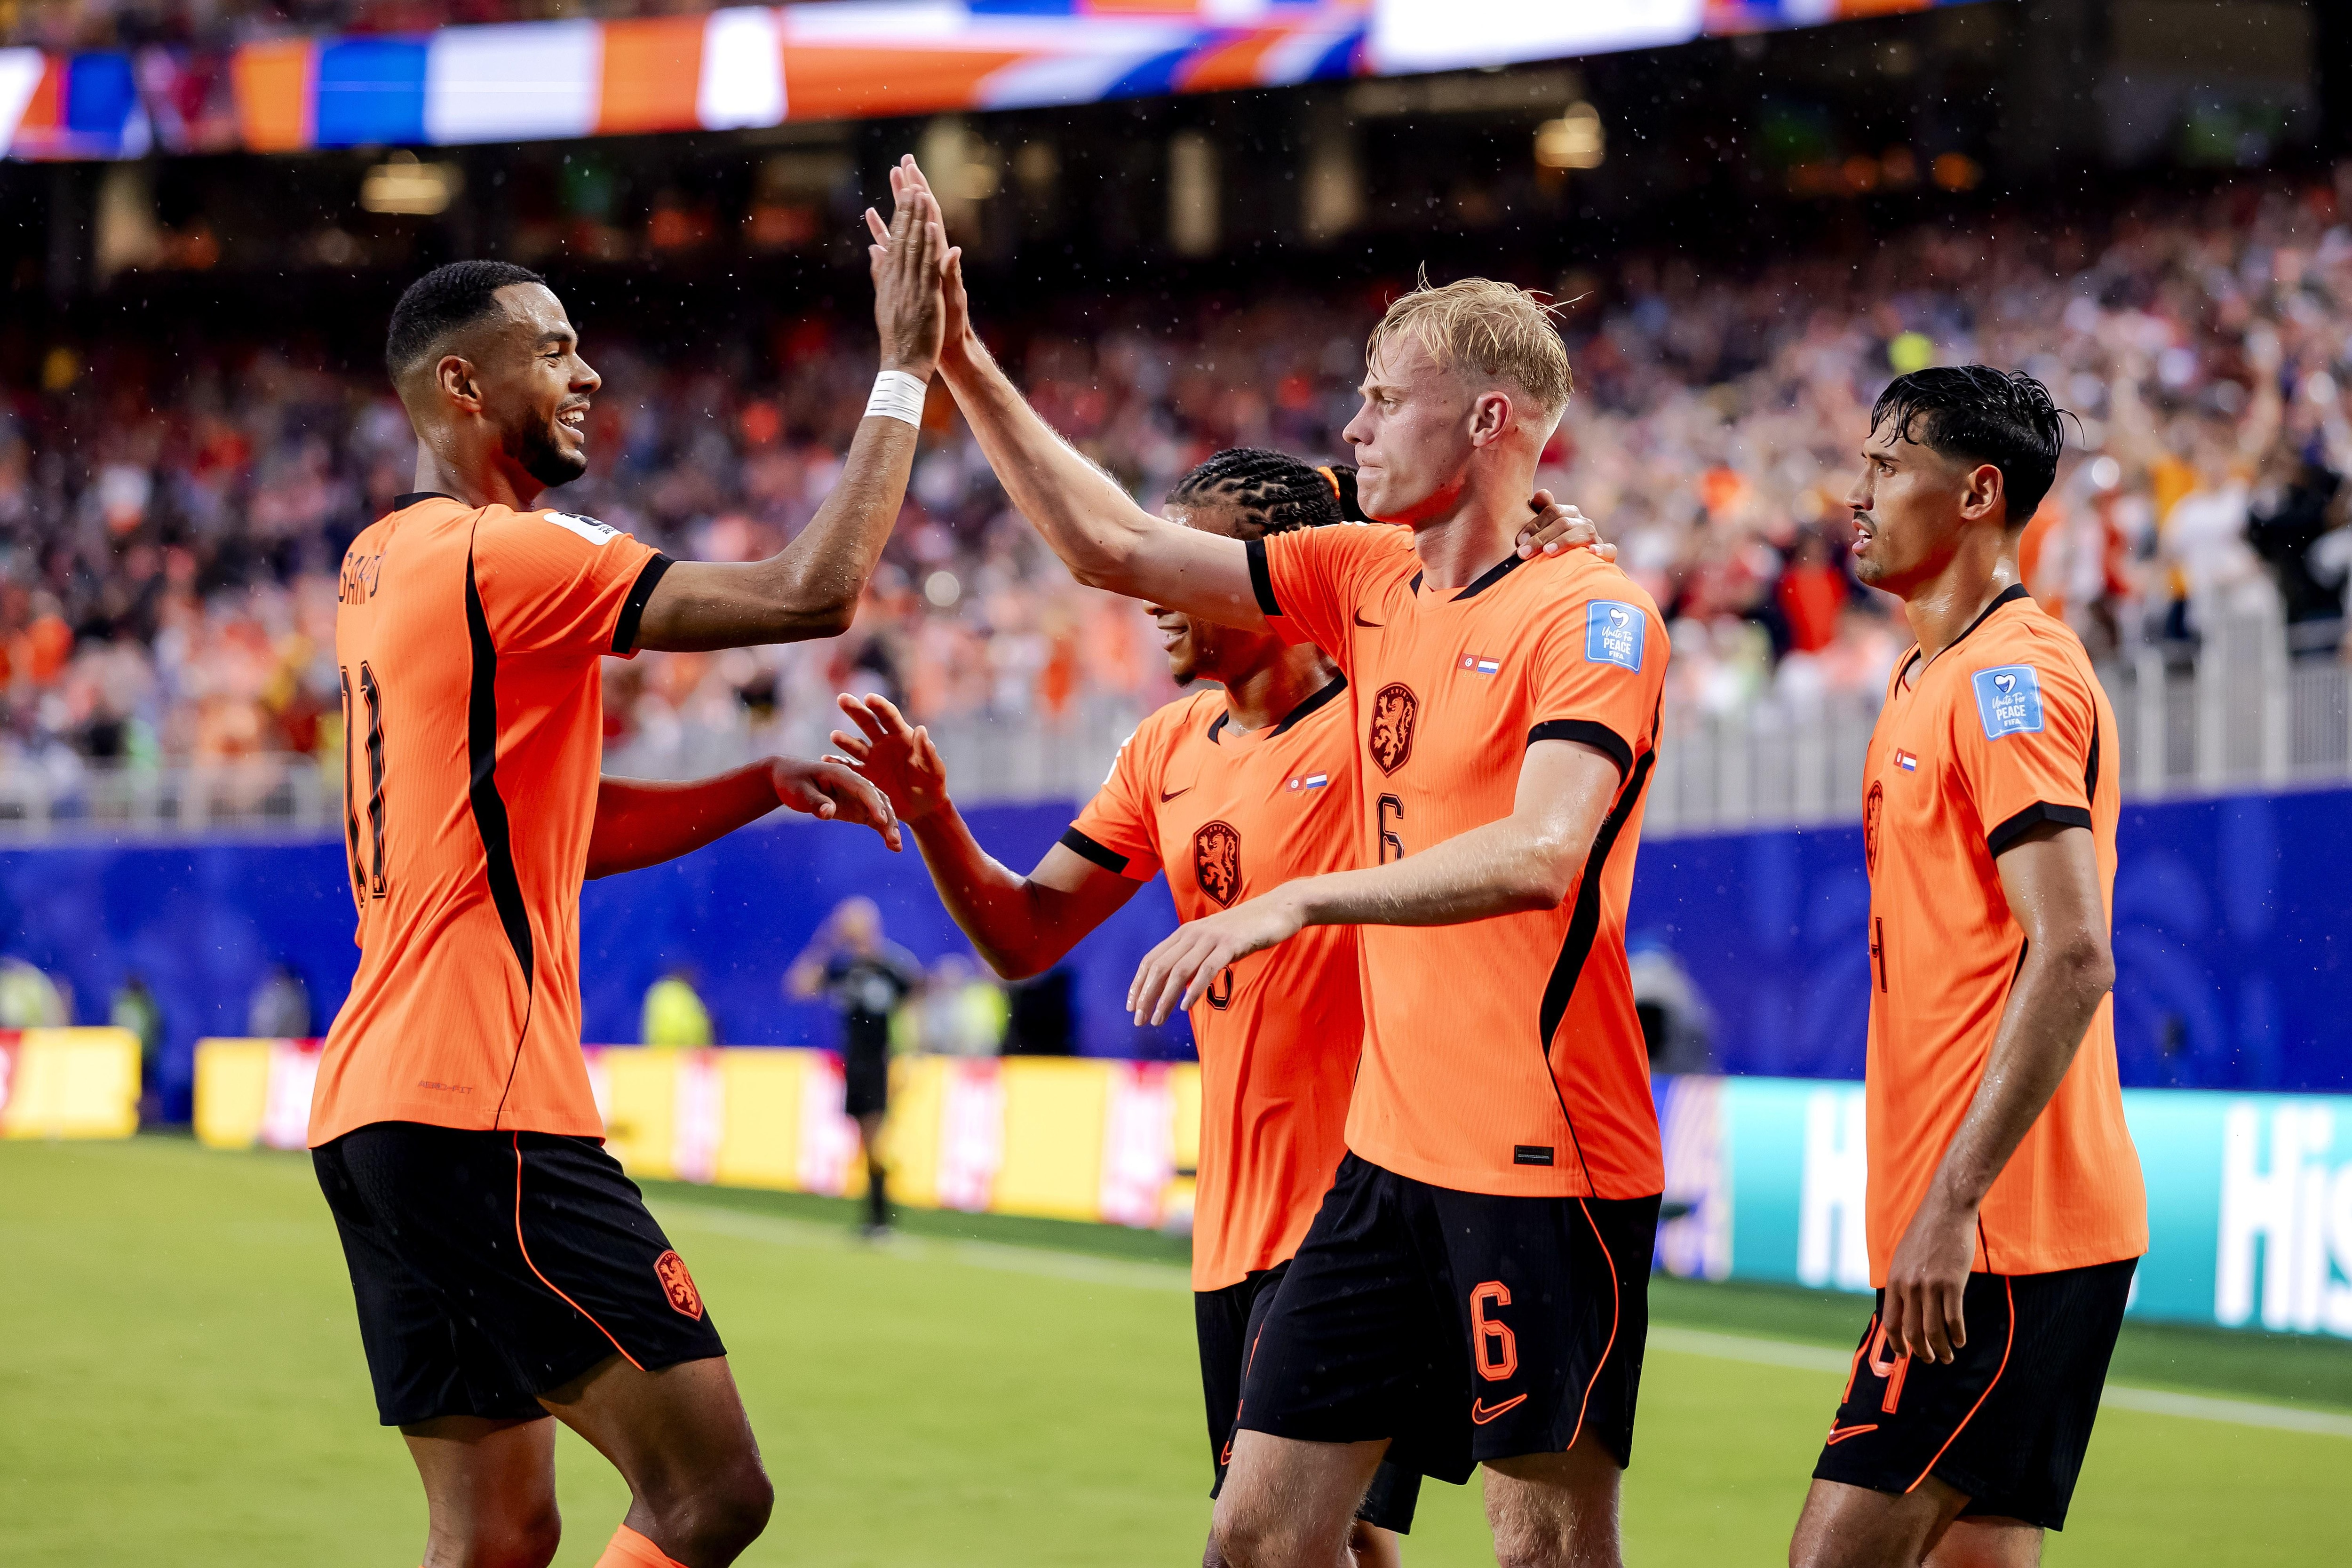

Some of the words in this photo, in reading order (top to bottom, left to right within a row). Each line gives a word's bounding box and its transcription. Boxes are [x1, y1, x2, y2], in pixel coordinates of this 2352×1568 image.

[1602, 626, 1623, 637] Unite
[1622, 631, 1633, 642] For
[1604, 638, 1631, 654] PEACE
[1609, 651, 1624, 660] FIFA
[1992, 695, 2013, 709] Unite
[2012, 692, 2026, 704] For
[1996, 705, 2026, 721] PEACE
[1470, 1280, 1518, 1381] 6
